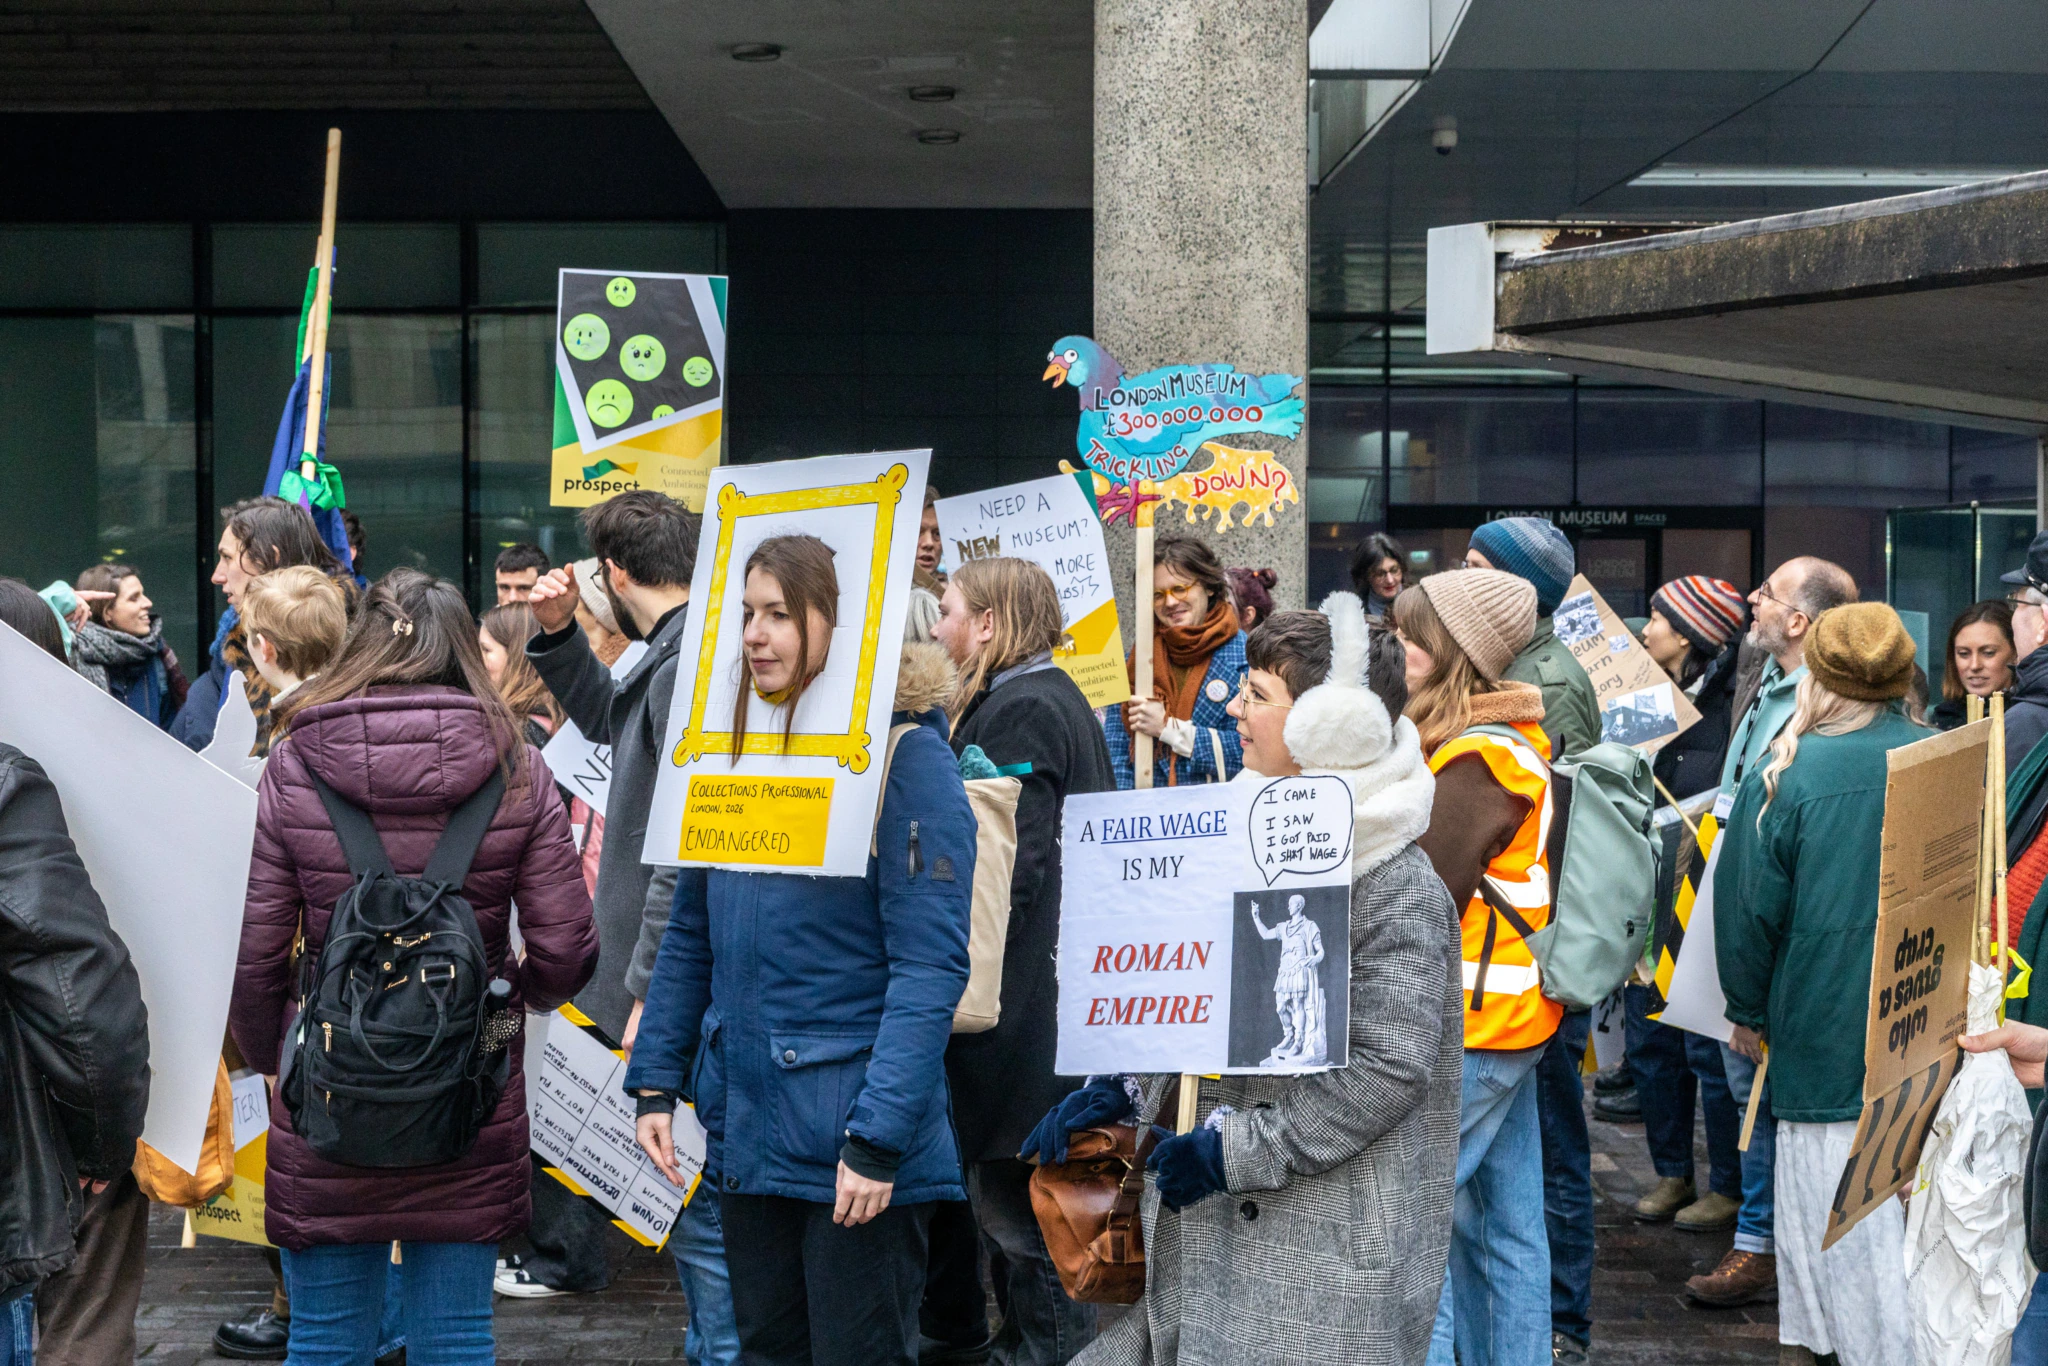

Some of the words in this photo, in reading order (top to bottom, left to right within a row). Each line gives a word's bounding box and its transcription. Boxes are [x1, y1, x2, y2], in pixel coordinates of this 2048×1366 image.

[1094, 384, 1169, 411] LONDON
[1169, 372, 1246, 398] MUSEUM
[1085, 438, 1189, 480] TRICKLING
[564, 479, 641, 495] prospect
[1192, 463, 1287, 505] DOWN?
[980, 494, 1026, 521] NEED
[1037, 492, 1051, 512] A
[1559, 510, 1628, 525] MUSEUM
[956, 533, 1001, 563] NEW
[1012, 518, 1088, 549] MUSEUM?
[1055, 553, 1096, 576] MORE
[1070, 658, 1118, 676] Connected.
[691, 781, 758, 798] COLLECTIONS
[761, 783, 828, 799] PROFESSIONAL
[1263, 789, 1278, 804] I
[1284, 788, 1316, 802] CAME
[690, 803, 722, 815] LONDON,
[725, 803, 744, 815] 2026
[1080, 820, 1096, 843] A
[1101, 816, 1153, 842] FAIR
[1160, 810, 1228, 838] WAGE
[1265, 816, 1276, 830] I
[1283, 812, 1314, 828] SAW
[685, 825, 790, 854] ENDANGERED
[1266, 835, 1276, 847] I
[1280, 831, 1302, 845] GOT
[1306, 831, 1331, 844] PAID
[1265, 852, 1275, 865] A
[1309, 846, 1338, 860] WAGE
[1122, 858, 1142, 881] IS
[1149, 855, 1185, 880] MY
[1090, 940, 1215, 974] ROMAN
[1894, 926, 1935, 974] crap
[1893, 943, 1945, 1012] gives
[1084, 994, 1214, 1027] EMPIRE
[1879, 986, 1892, 1020] a
[1888, 1004, 1928, 1060] who
[554, 1089, 567, 1100] IN
[604, 1096, 618, 1108] THE
[566, 1098, 585, 1115] NOT
[619, 1108, 632, 1119] FOR
[581, 1145, 602, 1165] WAGE
[624, 1144, 643, 1162] BEING
[565, 1156, 620, 1200] DESCRIPTION
[602, 1162, 620, 1179] FAIR
[195, 1203, 242, 1224] prospect
[631, 1202, 655, 1224] NUM
